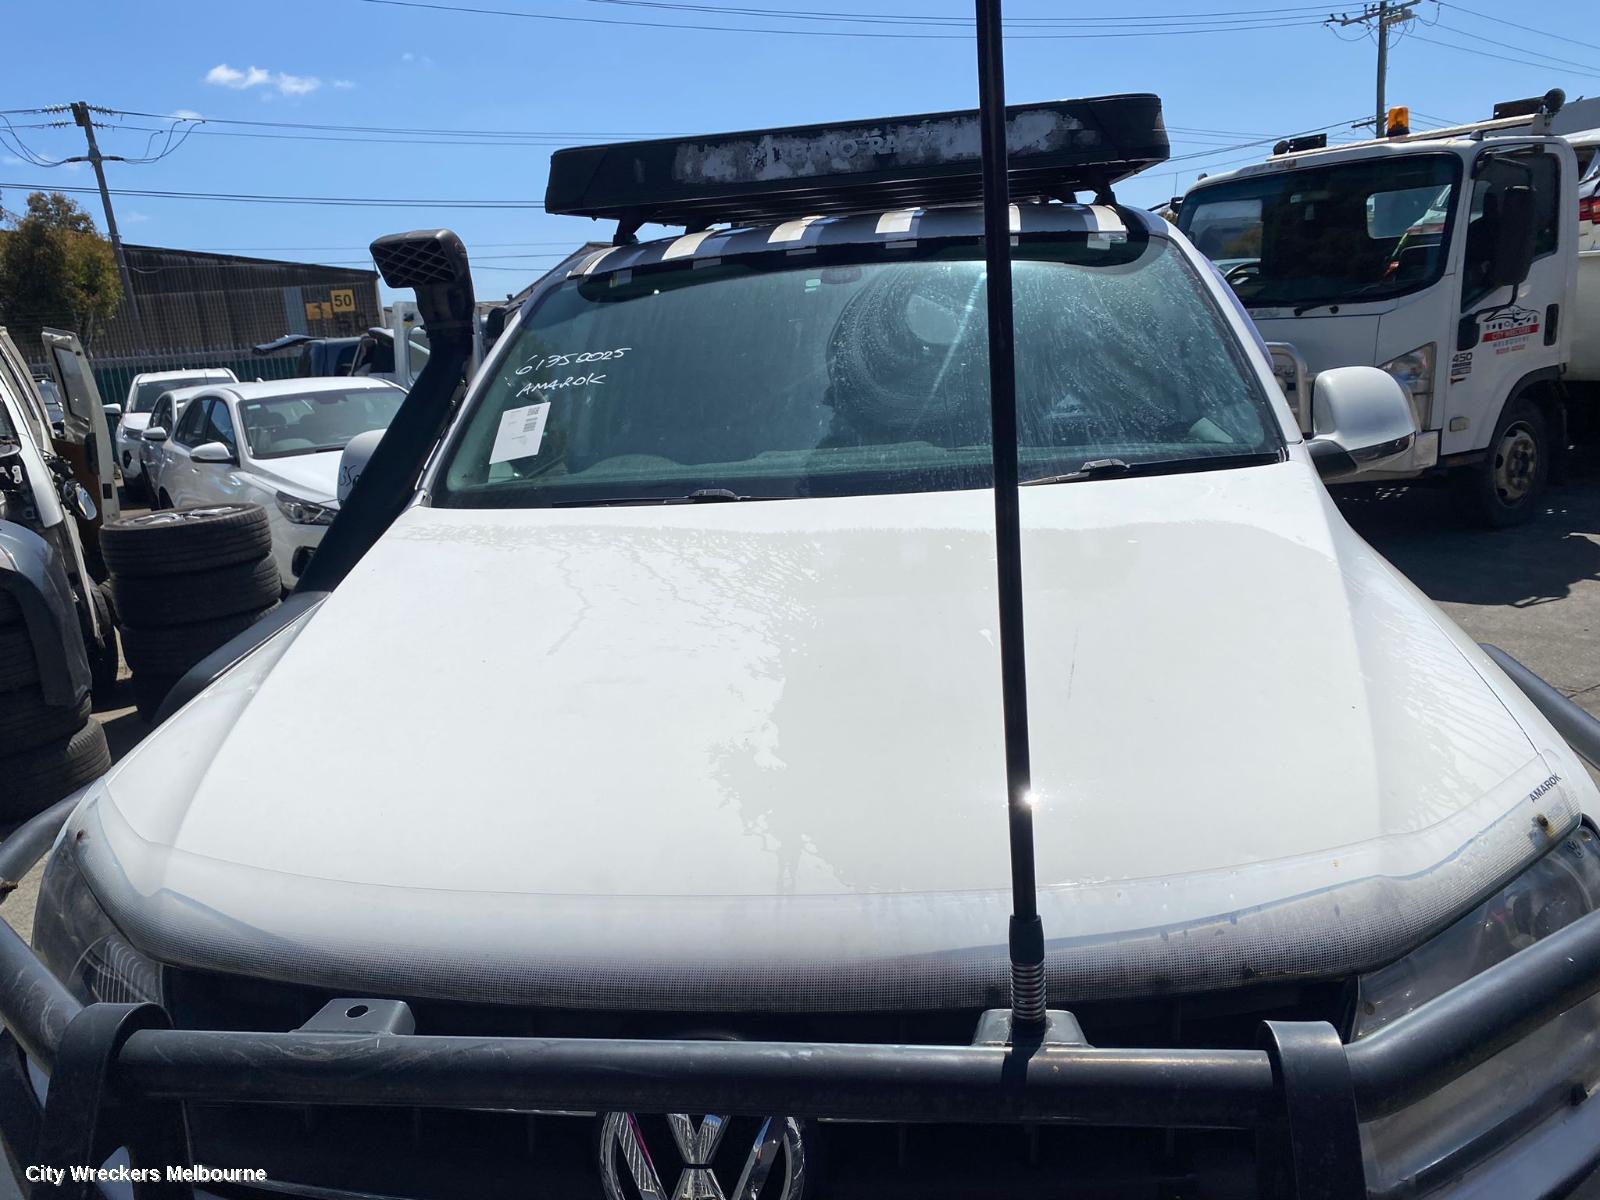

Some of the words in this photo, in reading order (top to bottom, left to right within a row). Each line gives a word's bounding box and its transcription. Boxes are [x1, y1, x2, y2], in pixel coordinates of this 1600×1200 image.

[334, 294, 352, 307] 50
[1452, 352, 1472, 361] 450
[516, 373, 607, 397] AMAROK
[1529, 772, 1562, 802] AMAROK
